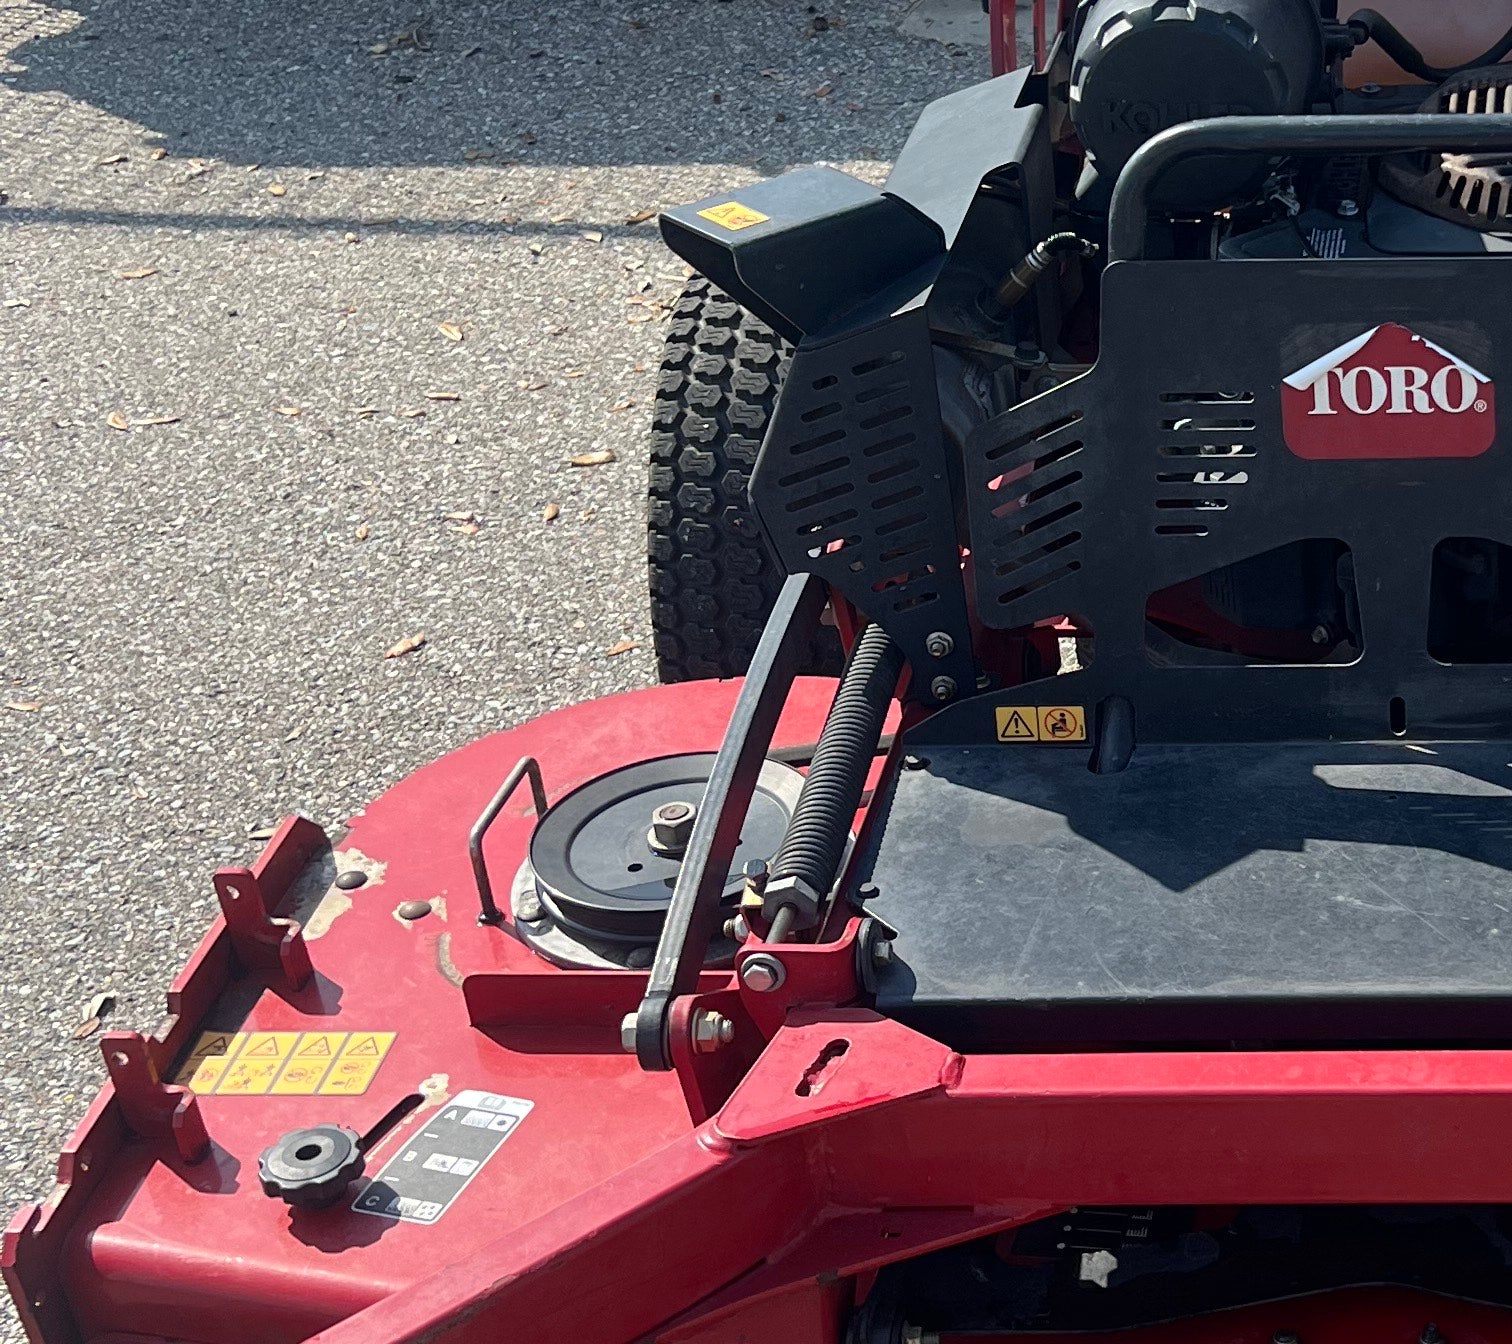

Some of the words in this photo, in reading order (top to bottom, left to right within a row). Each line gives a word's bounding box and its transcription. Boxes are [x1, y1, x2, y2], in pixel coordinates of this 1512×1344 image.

[443, 1108, 458, 1121] A
[402, 1150, 418, 1162] B
[365, 1195, 380, 1207] C
